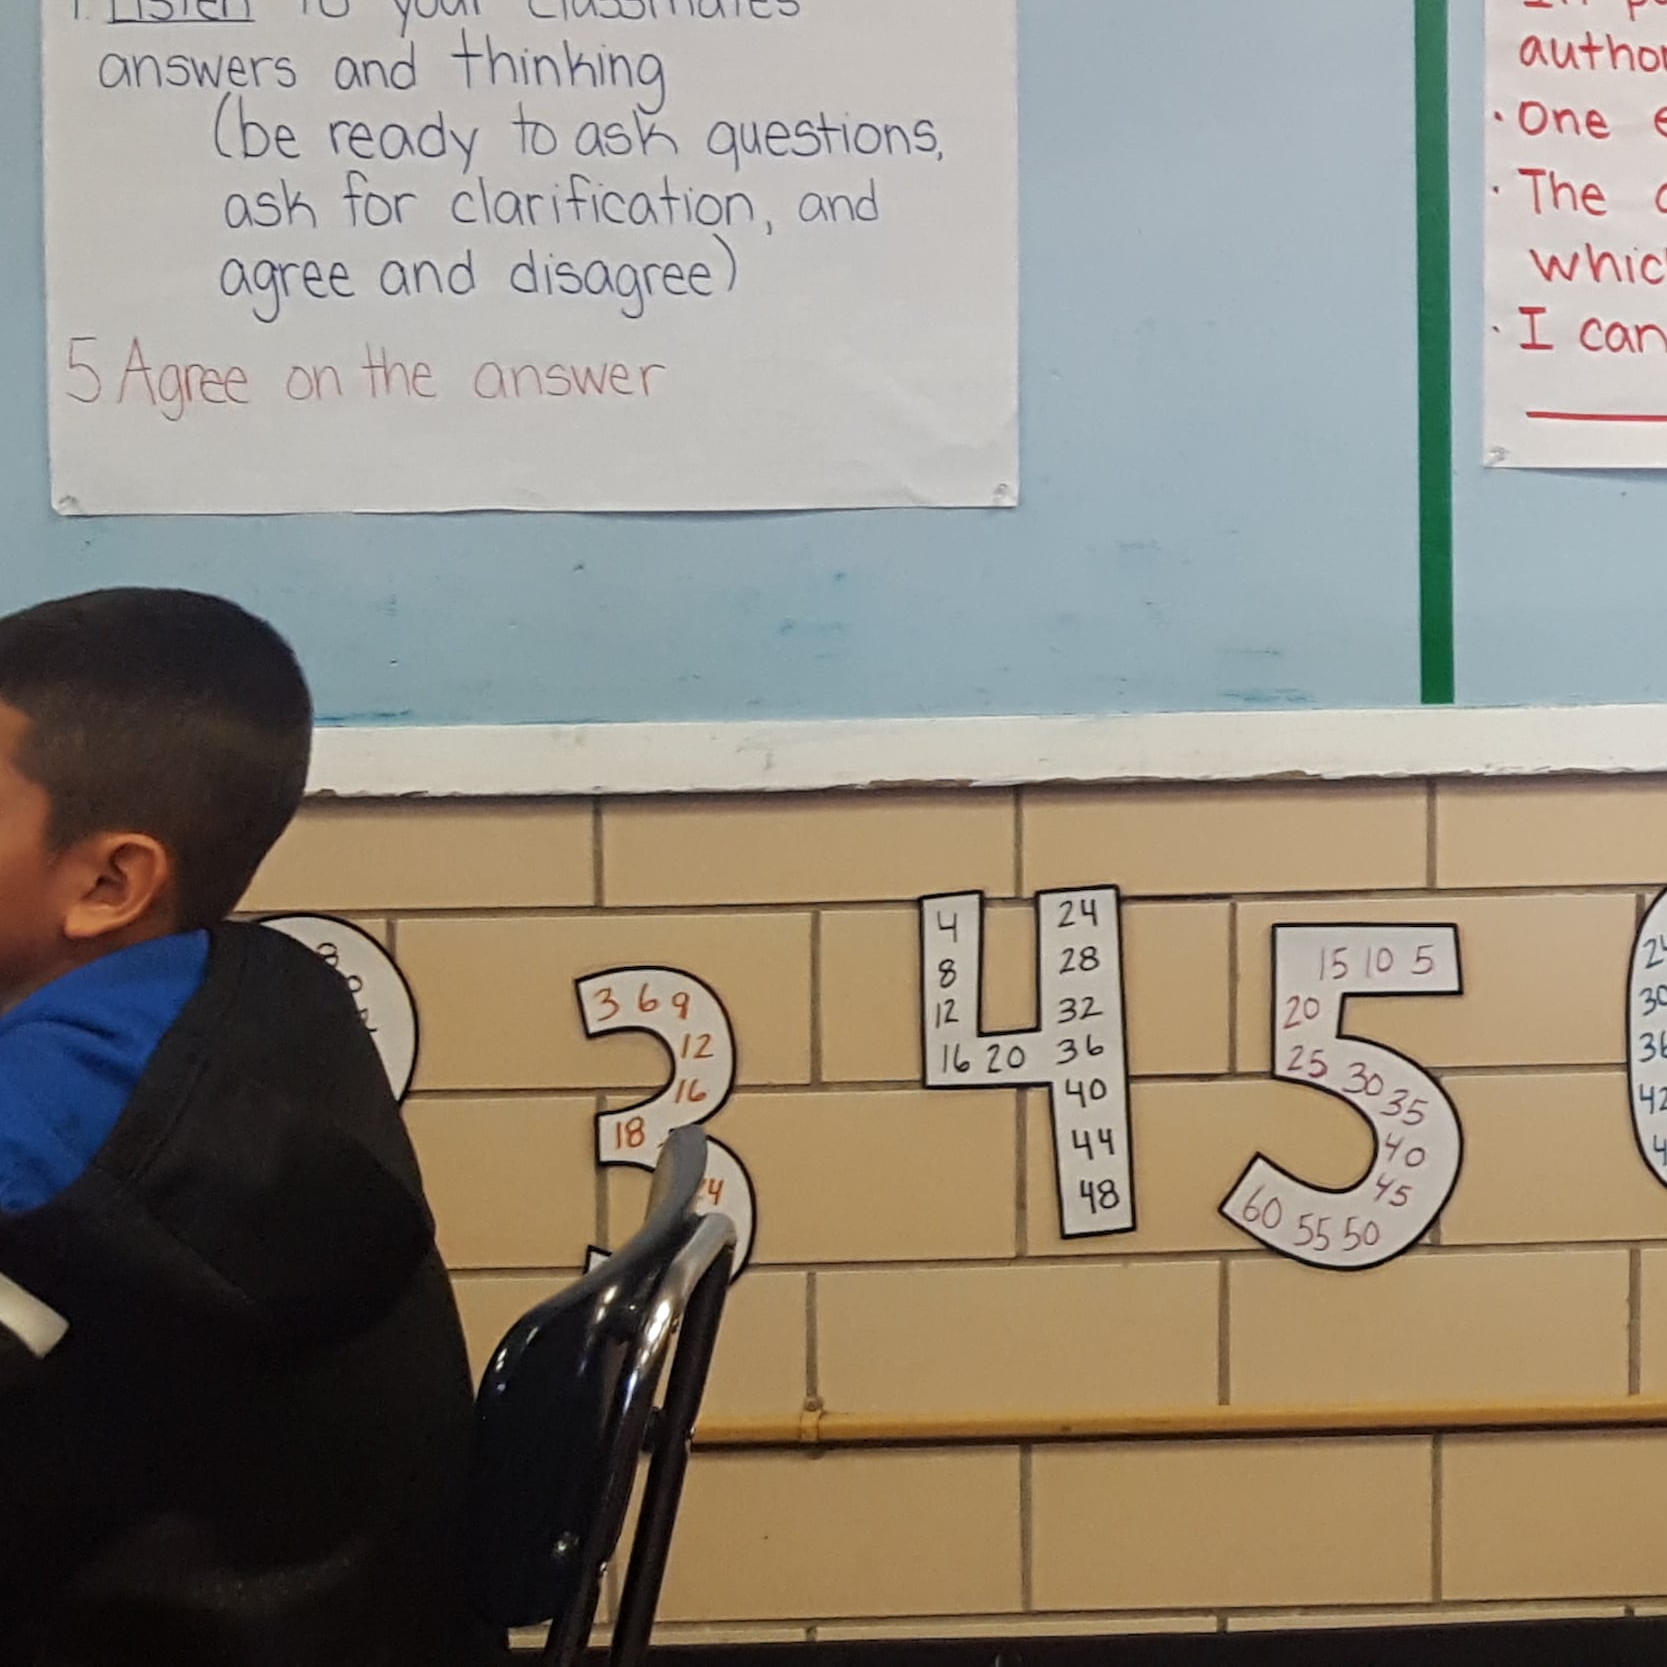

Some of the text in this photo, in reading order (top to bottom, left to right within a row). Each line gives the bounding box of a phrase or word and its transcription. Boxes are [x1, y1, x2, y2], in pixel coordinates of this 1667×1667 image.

[1517, 100, 1612, 140] One
[223, 169, 879, 236] ask for clarification, and
[1058, 899, 1099, 928] 24
[1059, 946, 1100, 975] 28
[1319, 944, 1435, 981] 15 10 5
[1057, 996, 1104, 1023] 32
[1283, 994, 1321, 1030] 20
